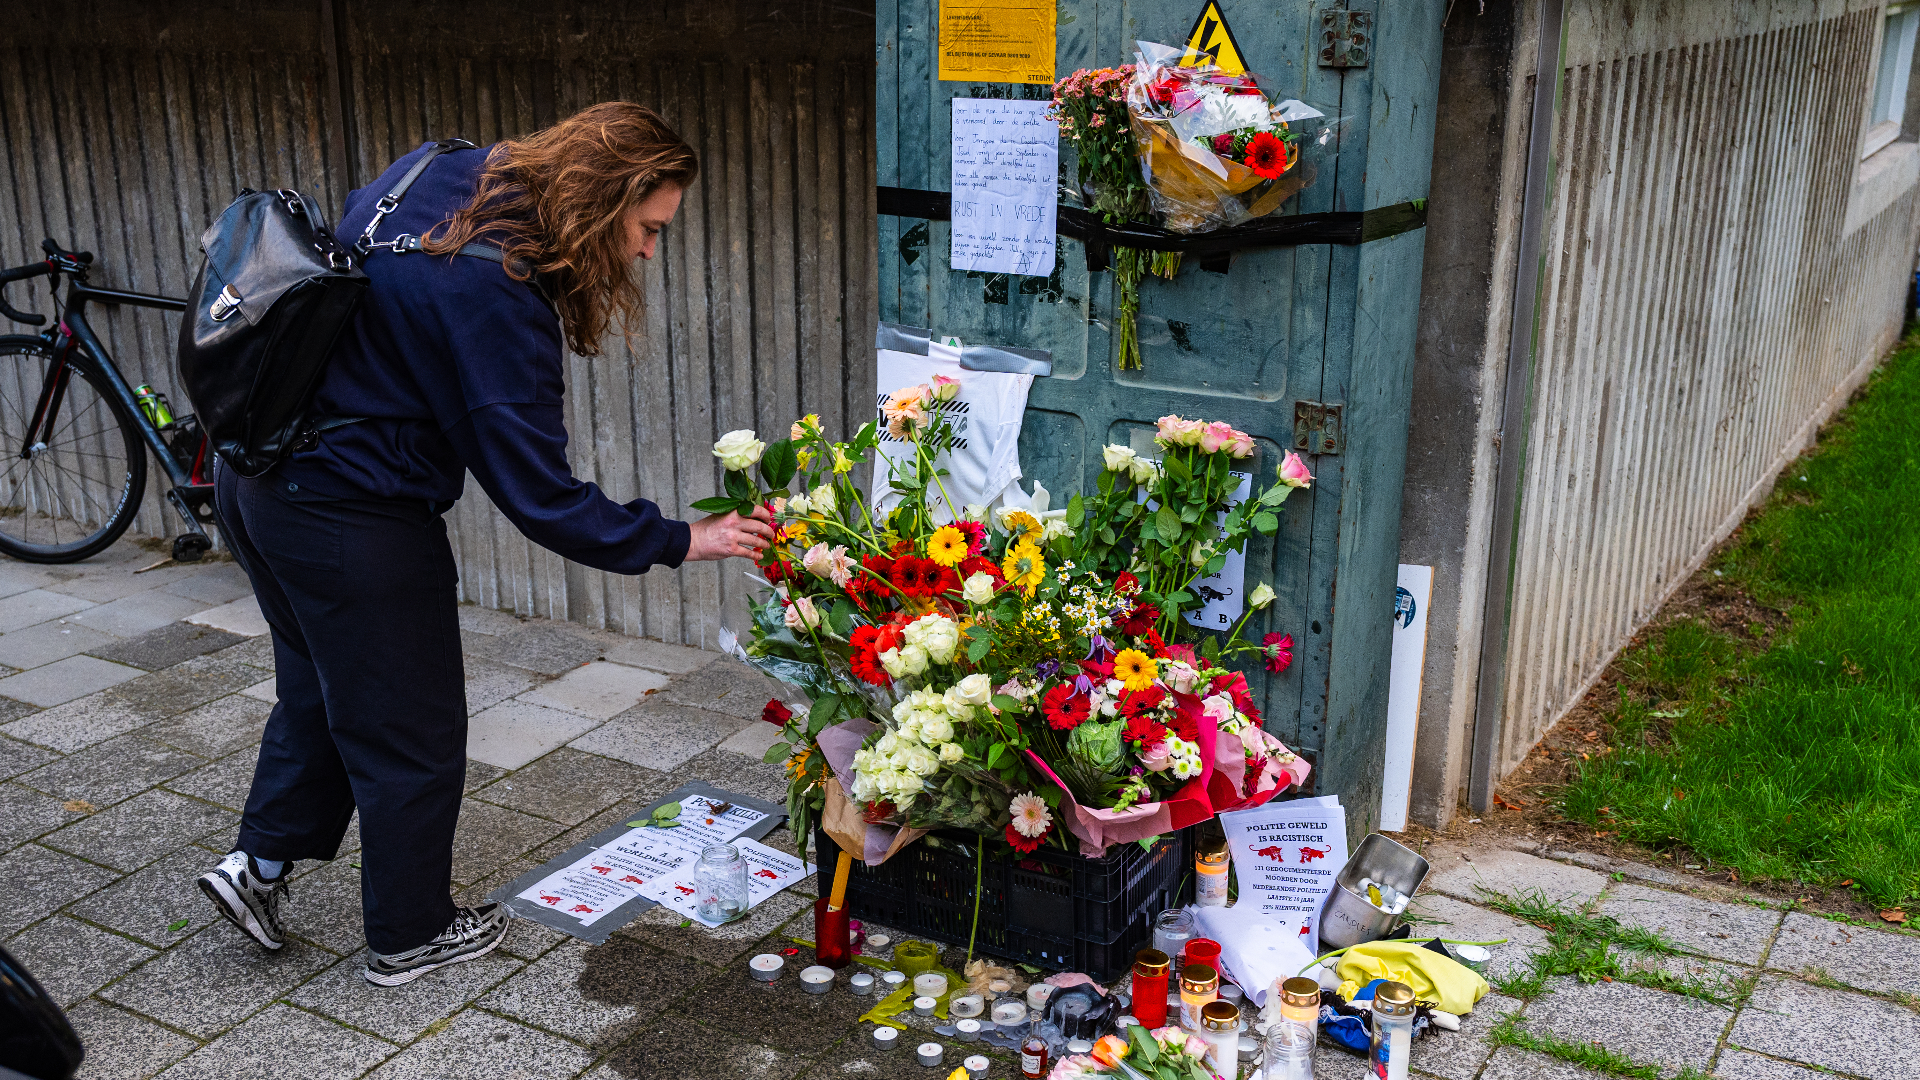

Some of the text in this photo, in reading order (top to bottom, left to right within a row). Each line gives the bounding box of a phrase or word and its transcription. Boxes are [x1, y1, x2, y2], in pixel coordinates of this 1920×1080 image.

[1027, 74, 1051, 82] STEDIN
[955, 201, 1046, 222] RUST IN VREDE
[1193, 610, 1228, 624] A B
[729, 807, 762, 821] KILLS
[1246, 822, 1328, 832] POLITIE GEWELD
[1258, 835, 1323, 843] IS RACISTISCH
[616, 846, 680, 869] WORLDWIDE
[770, 857, 801, 871] GEWELD
[1265, 866, 1332, 876] GEDOCUMENTEERDE
[1265, 874, 1319, 885] MOORDEN DOOR
[1252, 884, 1297, 892] NEDERLANDSE
[1267, 894, 1293, 902] LAATSTE
